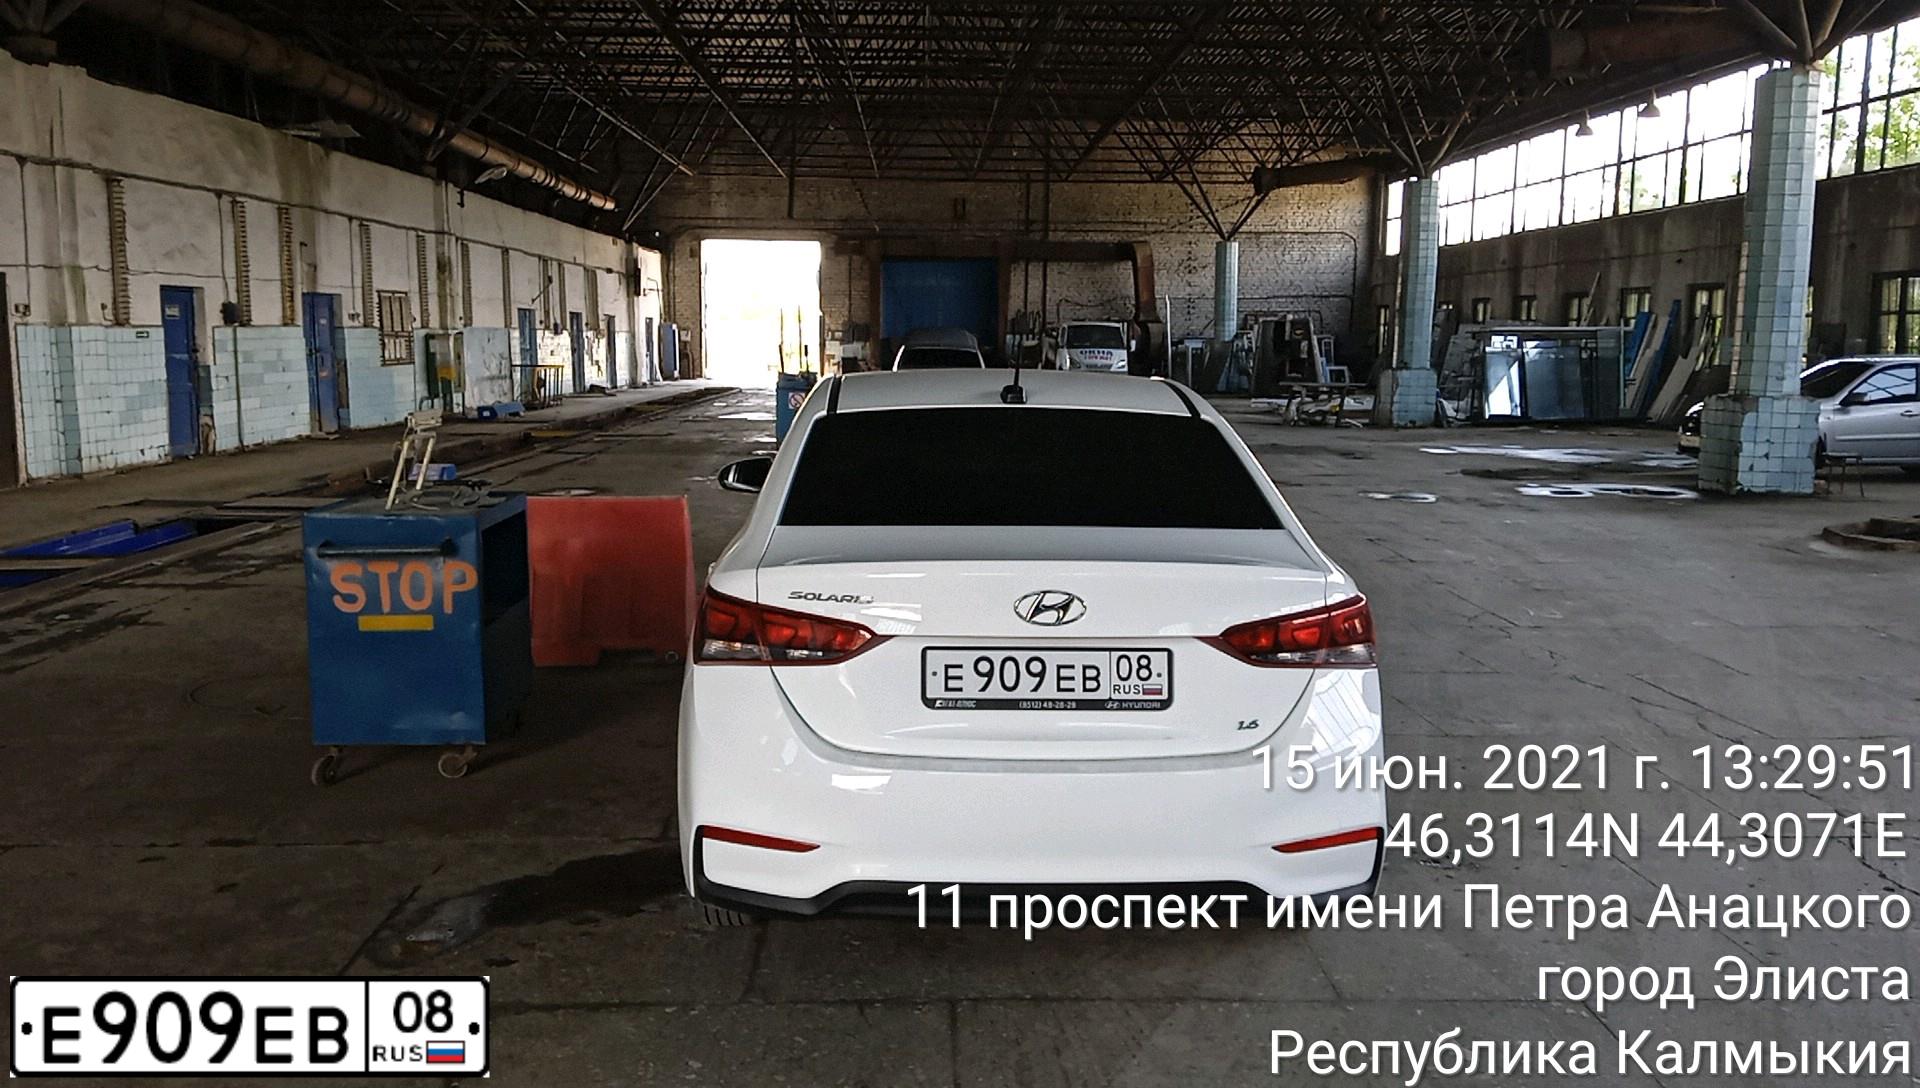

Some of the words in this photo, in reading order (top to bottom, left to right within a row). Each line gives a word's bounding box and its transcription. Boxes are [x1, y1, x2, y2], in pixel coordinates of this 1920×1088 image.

[330, 561, 479, 614] STOP
[1116, 654, 1152, 682] 08
[1113, 684, 1141, 695] RUS
[1122, 701, 1161, 709] HYUNDAI
